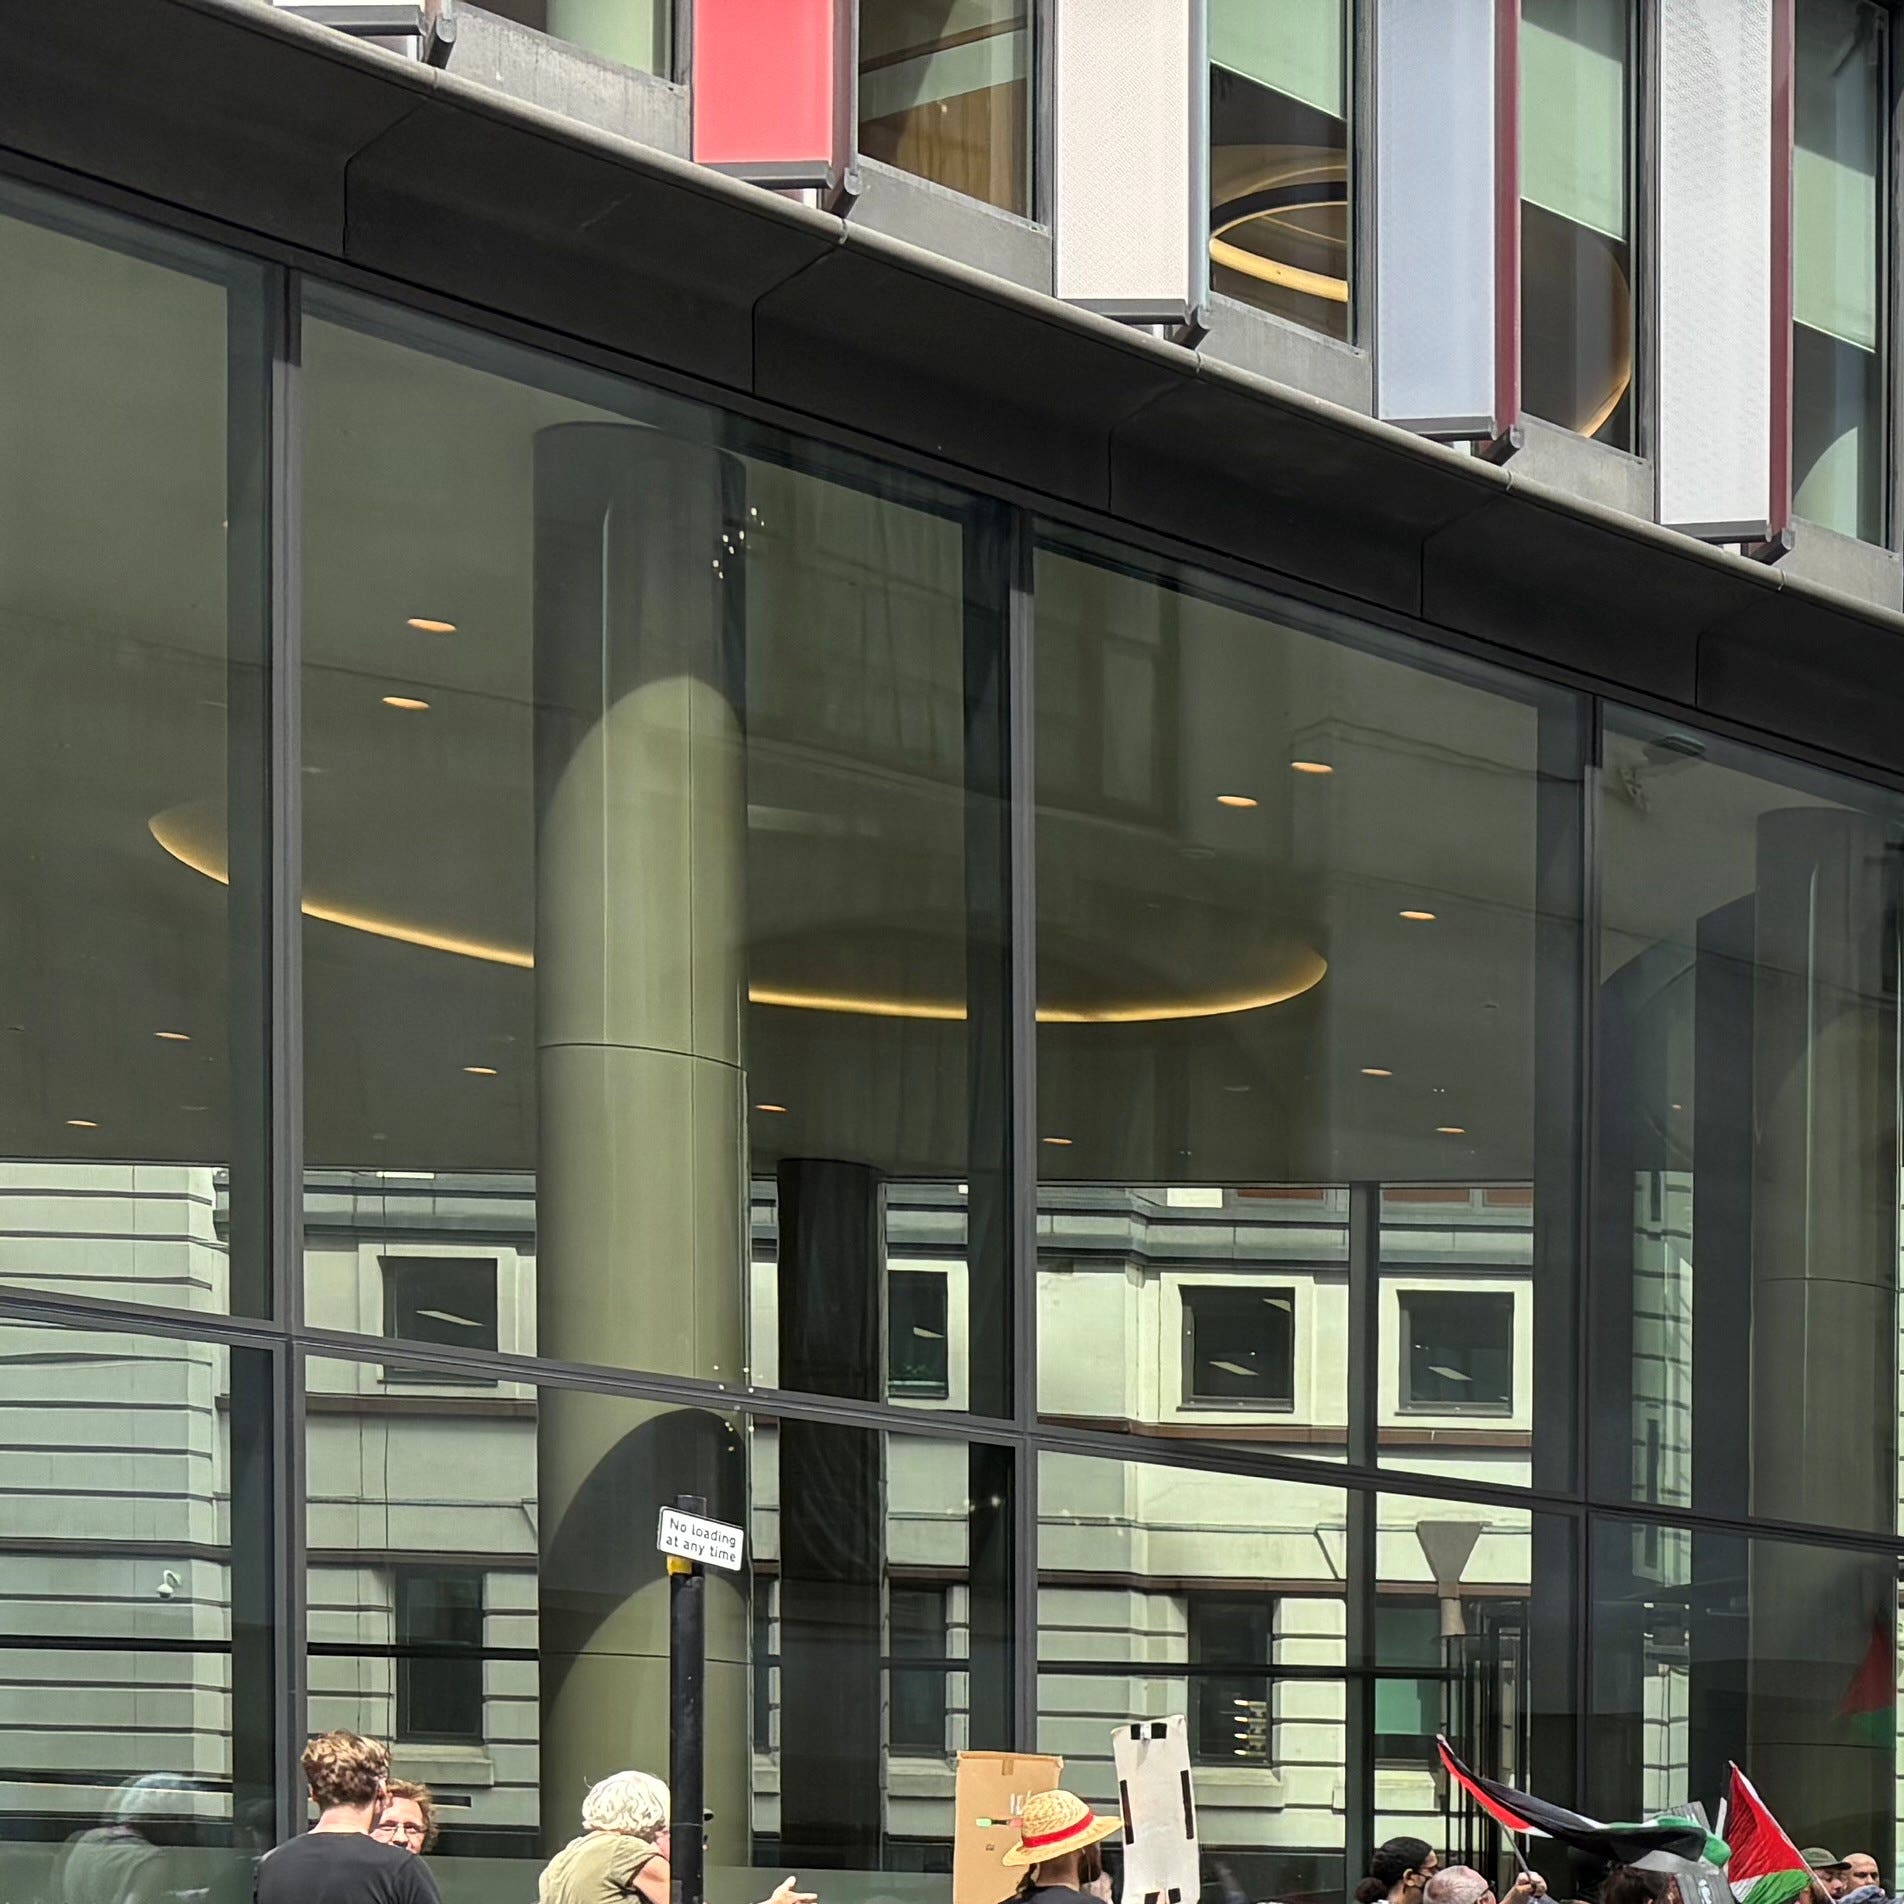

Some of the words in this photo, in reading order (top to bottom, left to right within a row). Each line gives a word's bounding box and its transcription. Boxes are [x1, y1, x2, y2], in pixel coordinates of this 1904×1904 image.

[669, 1517, 687, 1533] No
[691, 1523, 736, 1548] loading
[666, 1535, 678, 1547] at
[683, 1540, 705, 1556] any
[709, 1546, 736, 1562] time
